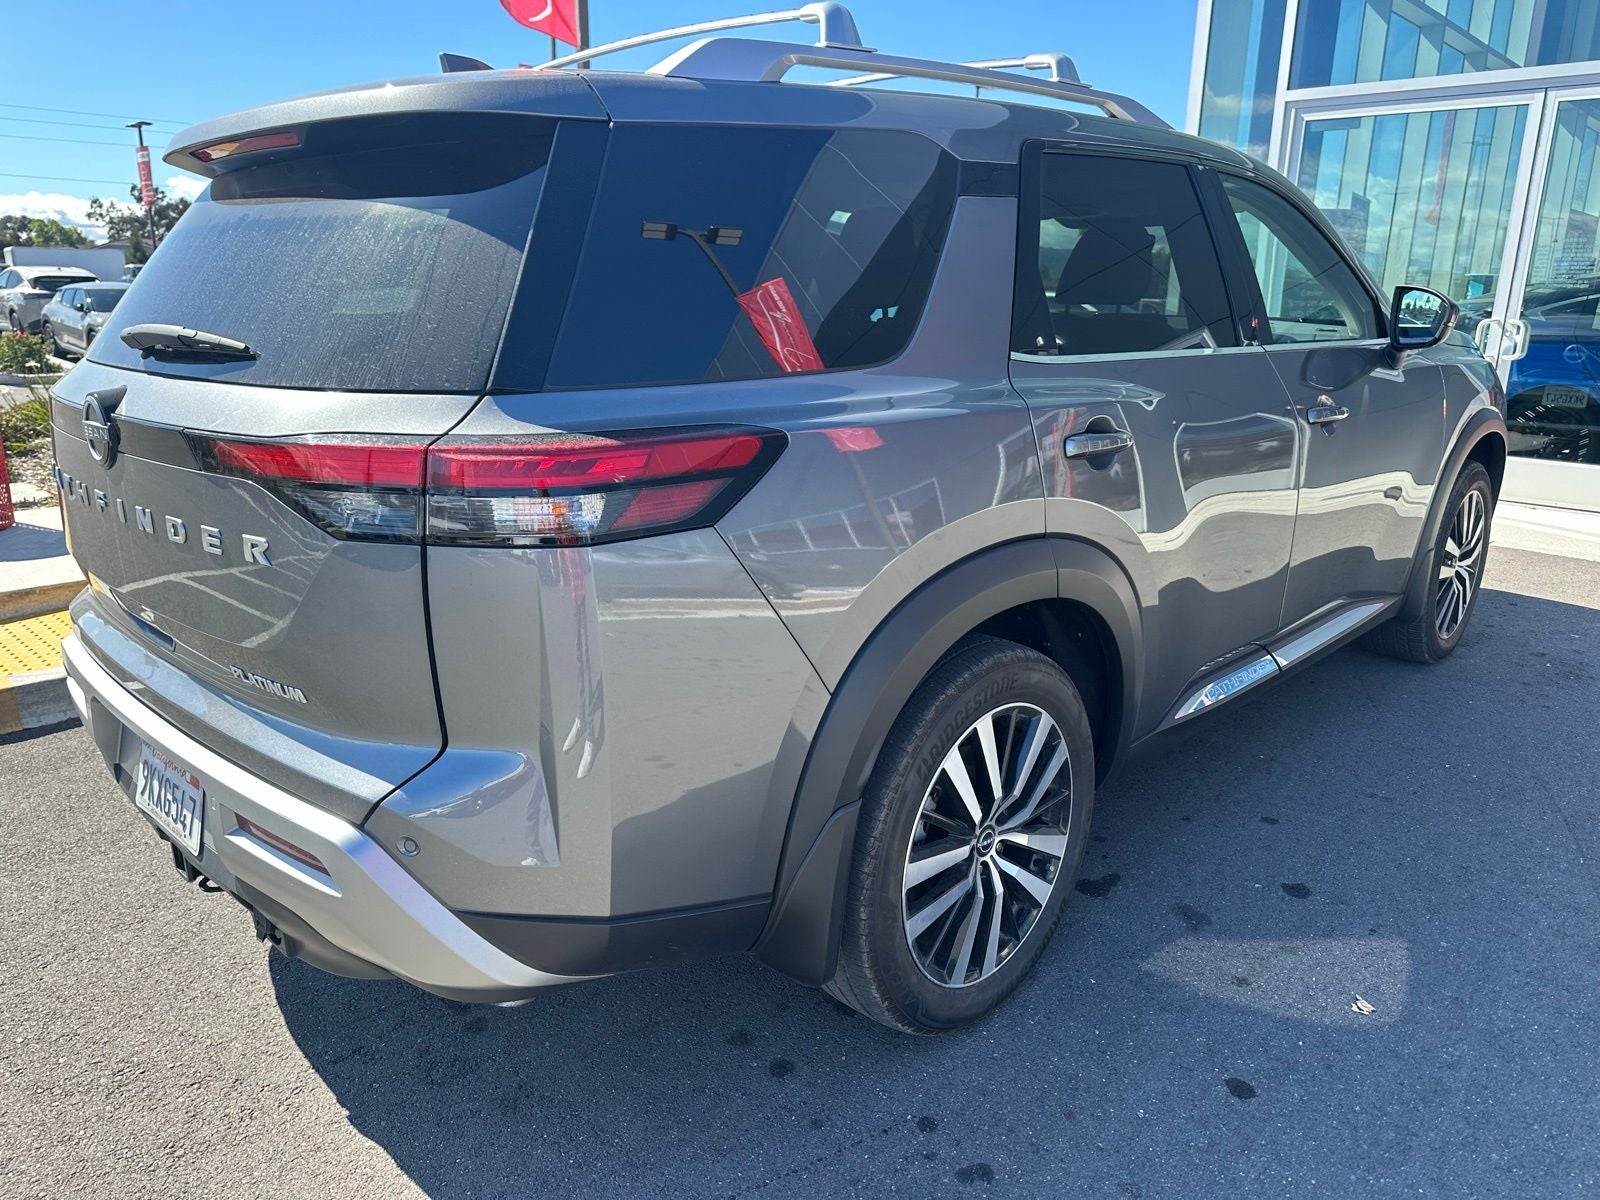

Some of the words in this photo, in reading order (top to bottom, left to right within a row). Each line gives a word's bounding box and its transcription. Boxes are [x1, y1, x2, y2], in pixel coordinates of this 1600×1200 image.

[51, 458, 272, 567] THFINDER
[229, 664, 308, 703] PLATINUM
[914, 671, 1020, 783] BRIDGESTONE
[141, 759, 197, 840] 9KXG547
